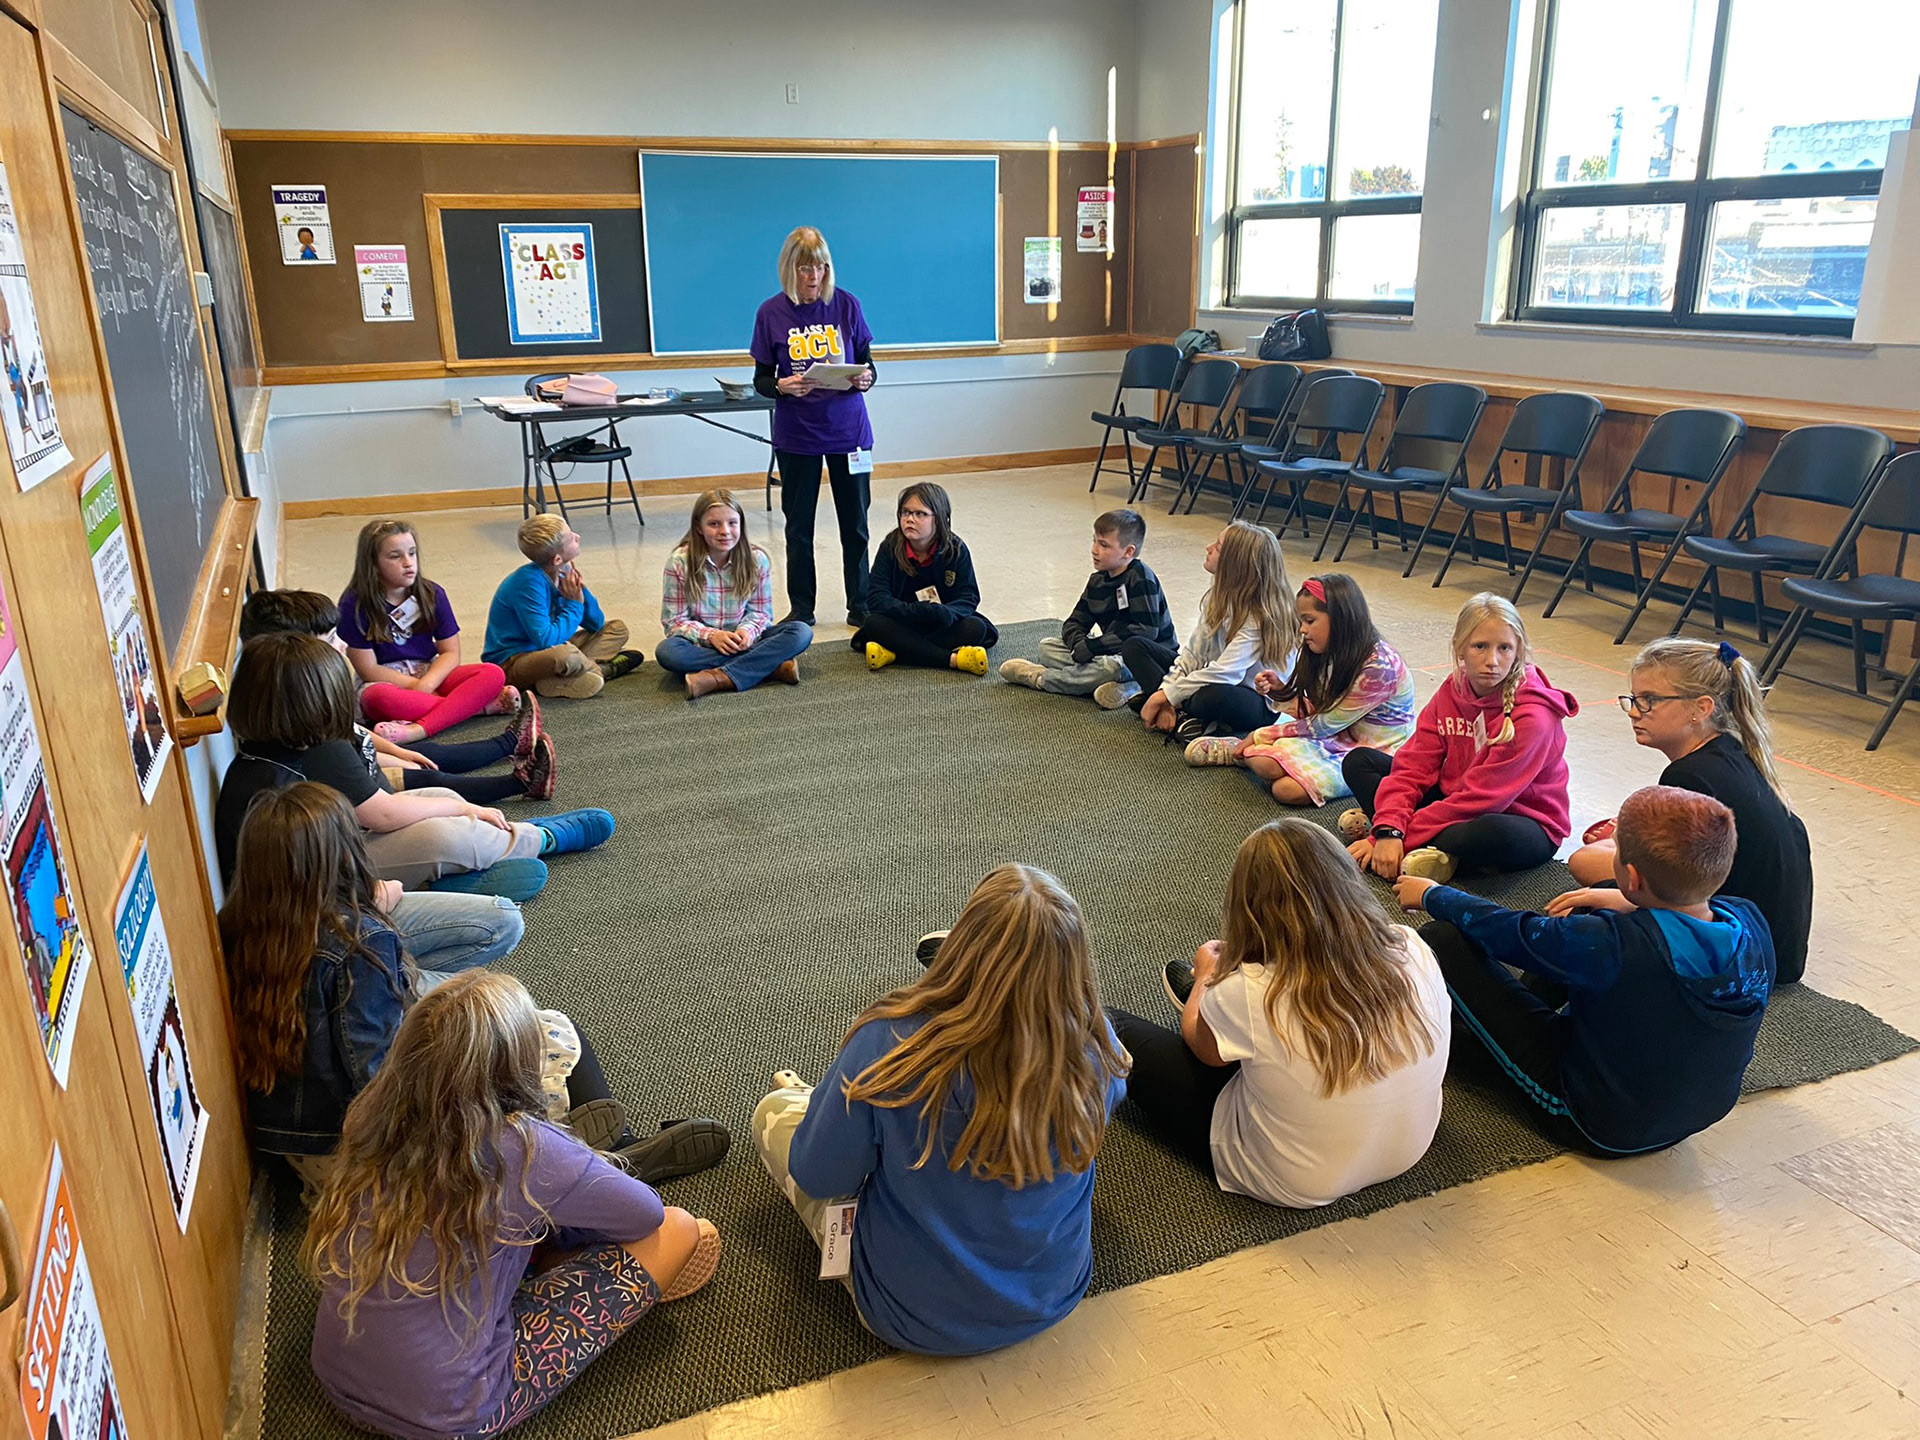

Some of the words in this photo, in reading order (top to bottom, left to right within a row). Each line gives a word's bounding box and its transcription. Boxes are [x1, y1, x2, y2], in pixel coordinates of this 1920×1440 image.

[280, 192, 320, 202] TRAGEDY
[1084, 192, 1106, 200] ASIDE
[362, 252, 398, 261] COMEDY
[518, 243, 585, 262] CLASS
[539, 262, 579, 281] ACT
[788, 324, 823, 337] CLASS
[787, 325, 841, 361] act
[1437, 716, 1474, 738] GREE
[4, 755, 15, 790] and
[827, 1222, 838, 1261] Grace
[28, 1204, 71, 1413] SETTING
